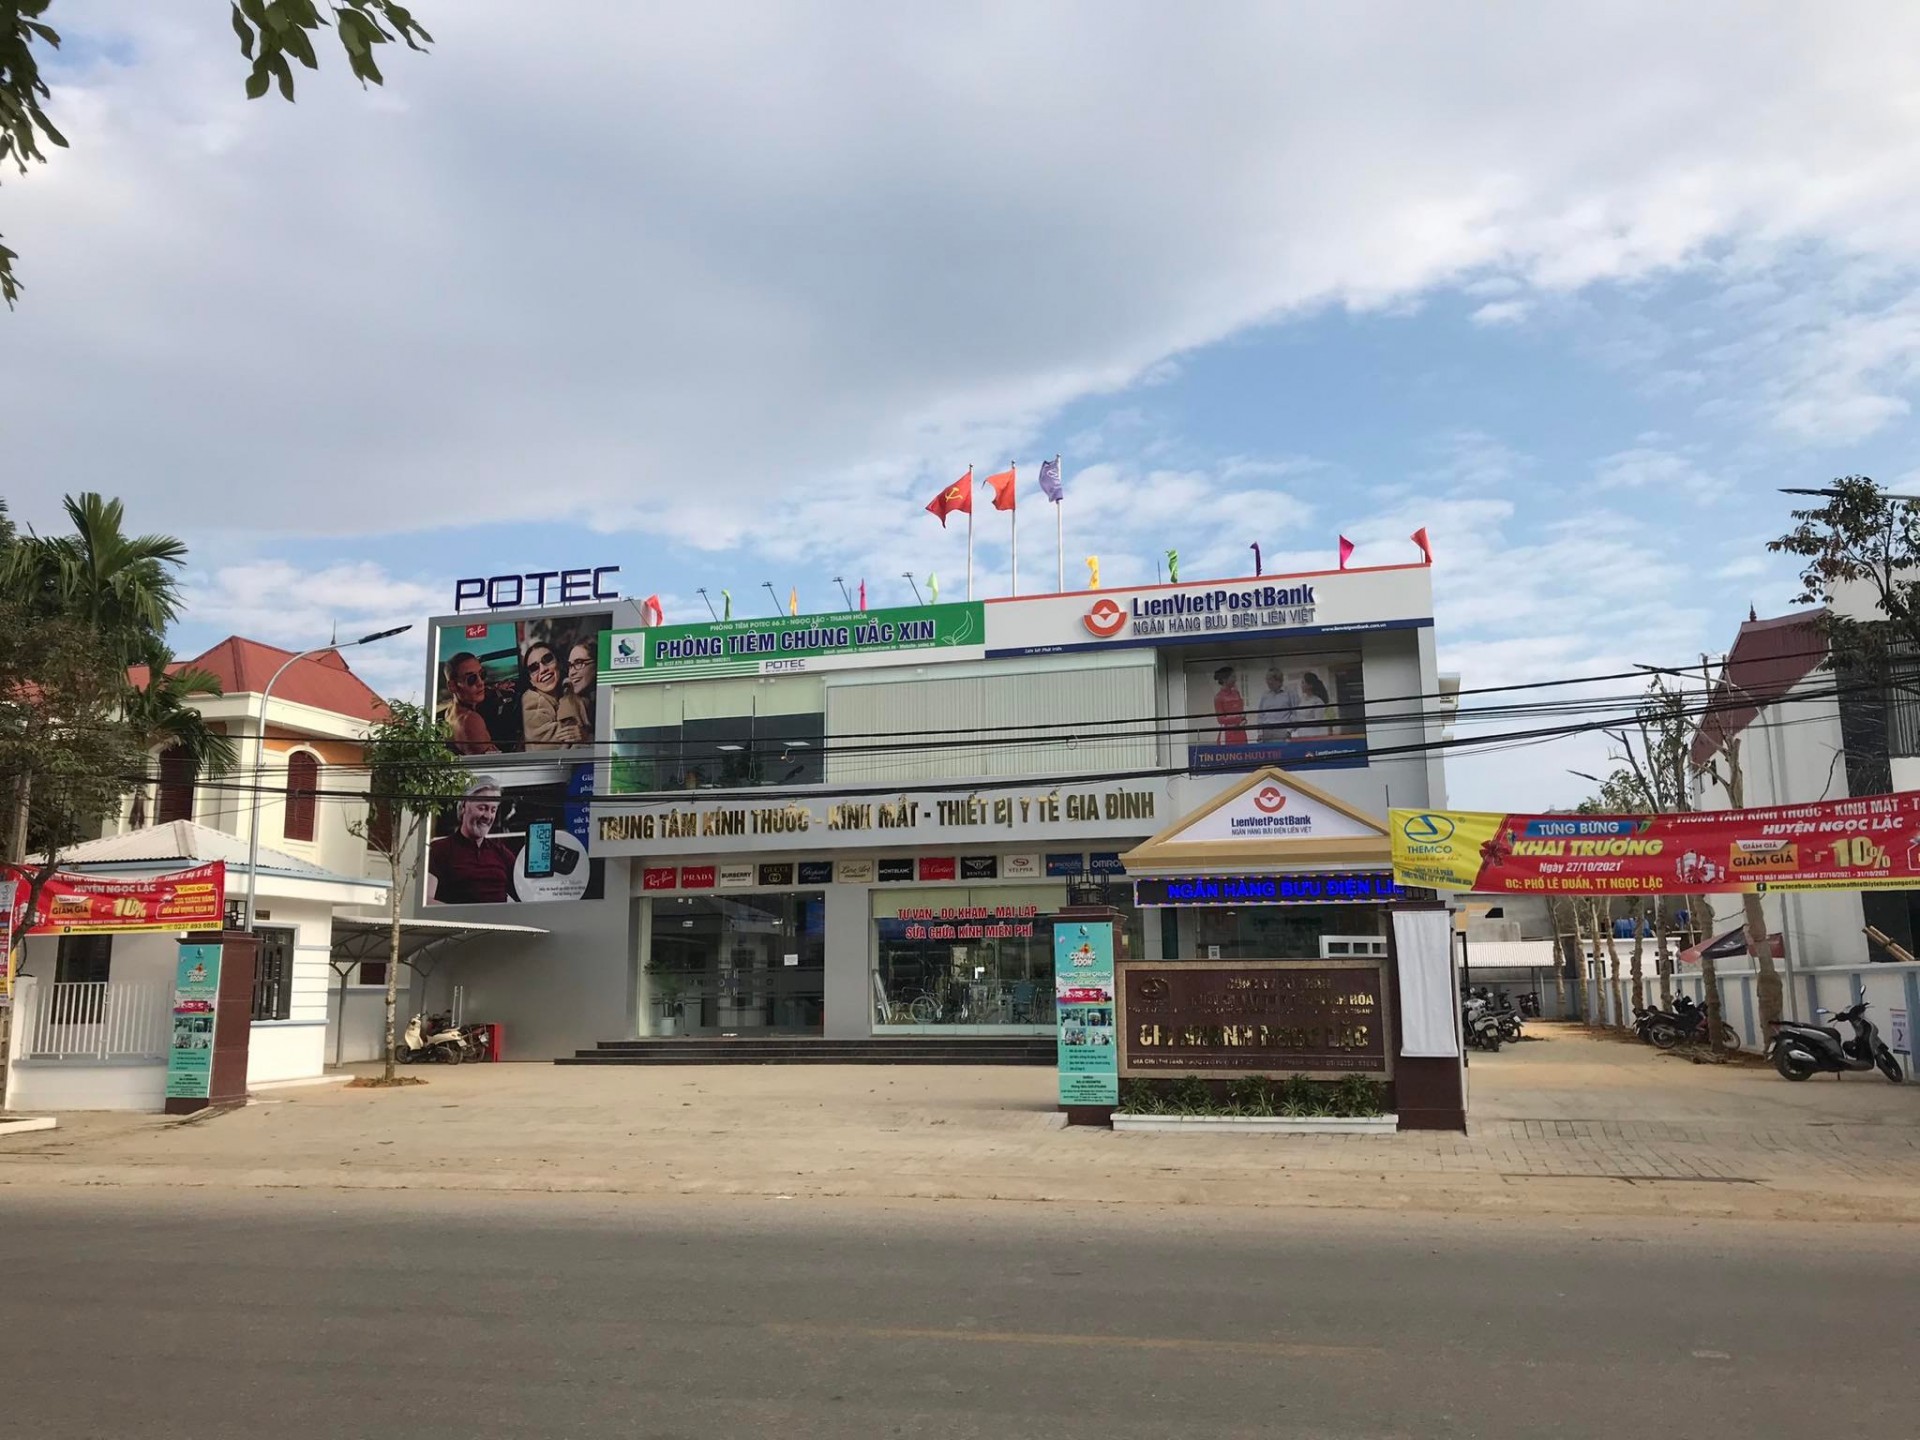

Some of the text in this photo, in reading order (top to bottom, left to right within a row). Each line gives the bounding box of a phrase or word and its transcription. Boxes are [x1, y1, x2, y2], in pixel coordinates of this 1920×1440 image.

[455, 566, 620, 611] POTEC
[1132, 584, 1315, 618] LienVietPostBank
[1133, 619, 1165, 636] NGÂN
[1169, 616, 1201, 632] HÀNG
[1232, 612, 1259, 630] ĐIỆN
[1289, 606, 1316, 625] VIỆT
[656, 634, 723, 660] PHÒNG
[728, 629, 777, 654] TIÊM
[781, 623, 849, 650] CHỦNG
[854, 617, 894, 645] VẮC
[898, 619, 936, 641] XIN
[613, 656, 641, 664] POTEC
[764, 659, 805, 670] POTEC
[598, 814, 654, 841] TRUNG
[659, 808, 698, 839] TÂM
[702, 805, 746, 837] KÍNH
[751, 799, 812, 834] THUỐC
[827, 800, 873, 831] KÍNH
[936, 790, 989, 826] THIẾT
[994, 797, 1013, 828] BỊ
[1019, 795, 1031, 824] Y
[1036, 786, 1060, 823] TẾ
[1066, 794, 1100, 822] GIA
[1105, 787, 1155, 821] ĐÌNH
[1231, 815, 1312, 828] LienVietPostBank
[1762, 813, 1904, 837] HUYỆN NGỌC LẶC
[1406, 845, 1453, 855] THEMCO
[1511, 837, 1664, 857] KHAI TRƯƠNG
[1732, 850, 1794, 867] GIẢM GIÁ
[721, 871, 752, 879] BURBERRY
[763, 865, 789, 873] GUCCI
[1539, 861, 1622, 874] Ngày 27/10/2021
[682, 872, 713, 881] PRADA
[1524, 875, 1545, 890] PHỐ
[1547, 876, 1560, 889] LÊ
[1595, 878, 1608, 889] TT
[1610, 878, 1640, 892] NGỌC
[106, 884, 136, 895] NGỌC
[1167, 881, 1219, 900] NGÂN
[1223, 877, 1276, 898] HÀNG
[1281, 880, 1322, 897] BƯU
[1326, 879, 1370, 899] ĐIỆN
[957, 923, 984, 939] KÍNH
[1014, 922, 1034, 937] PHÍ
[1073, 959, 1093, 967] SOON
